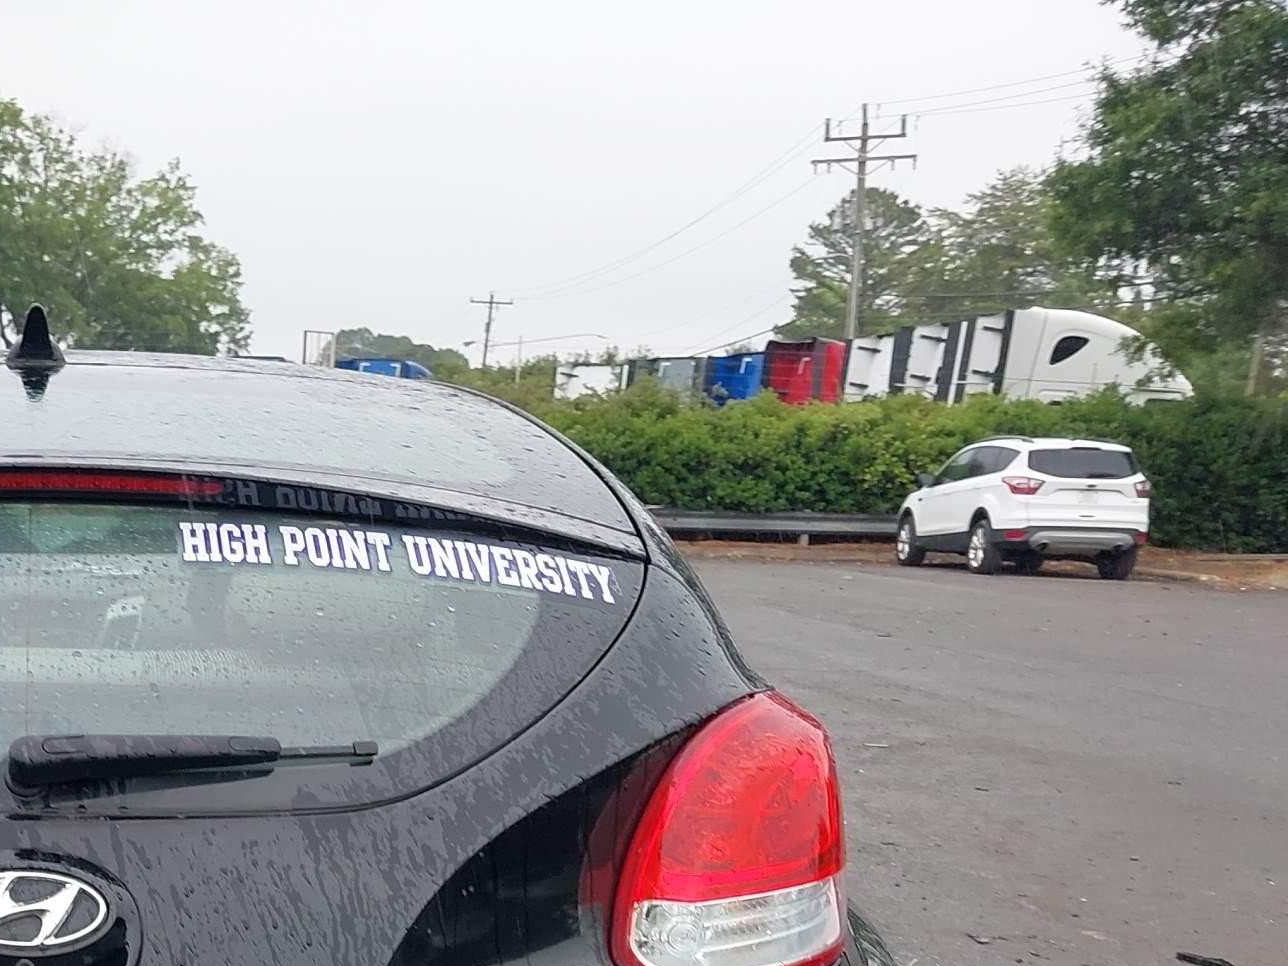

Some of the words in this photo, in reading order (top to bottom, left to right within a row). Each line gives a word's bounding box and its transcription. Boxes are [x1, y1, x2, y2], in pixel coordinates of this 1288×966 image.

[178, 522, 272, 565] HIGH
[279, 525, 392, 573] POINT
[401, 534, 617, 604] UNIVERSITY
